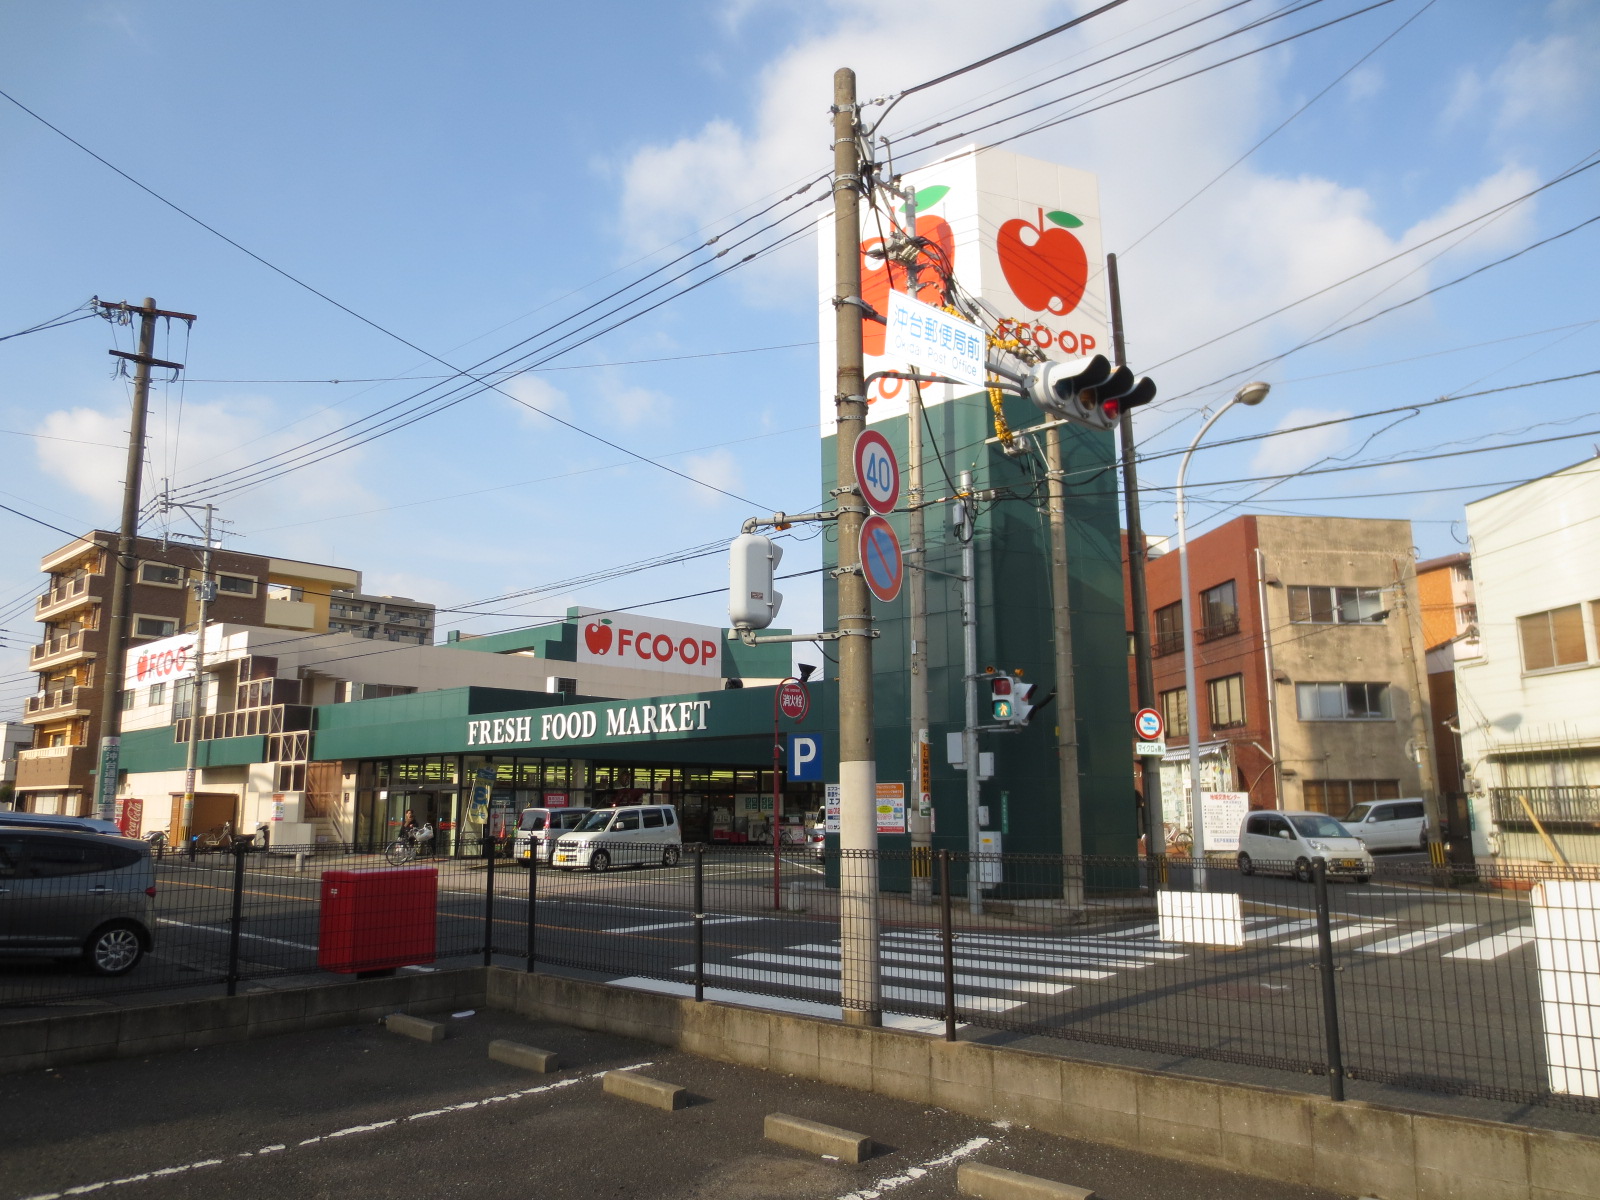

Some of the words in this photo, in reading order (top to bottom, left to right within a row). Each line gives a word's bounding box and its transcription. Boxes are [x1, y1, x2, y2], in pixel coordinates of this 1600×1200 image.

[893, 304, 980, 361] 沖台郵便局前
[895, 334, 921, 356] Okidai
[927, 346, 946, 366] Post
[952, 356, 977, 377] Office
[866, 452, 890, 492] 40
[782, 694, 803, 708] 消火栓
[467, 716, 532, 746] FRESH
[541, 710, 597, 741] FOOD
[606, 700, 711, 737] MARKET
[794, 737, 817, 776] P
